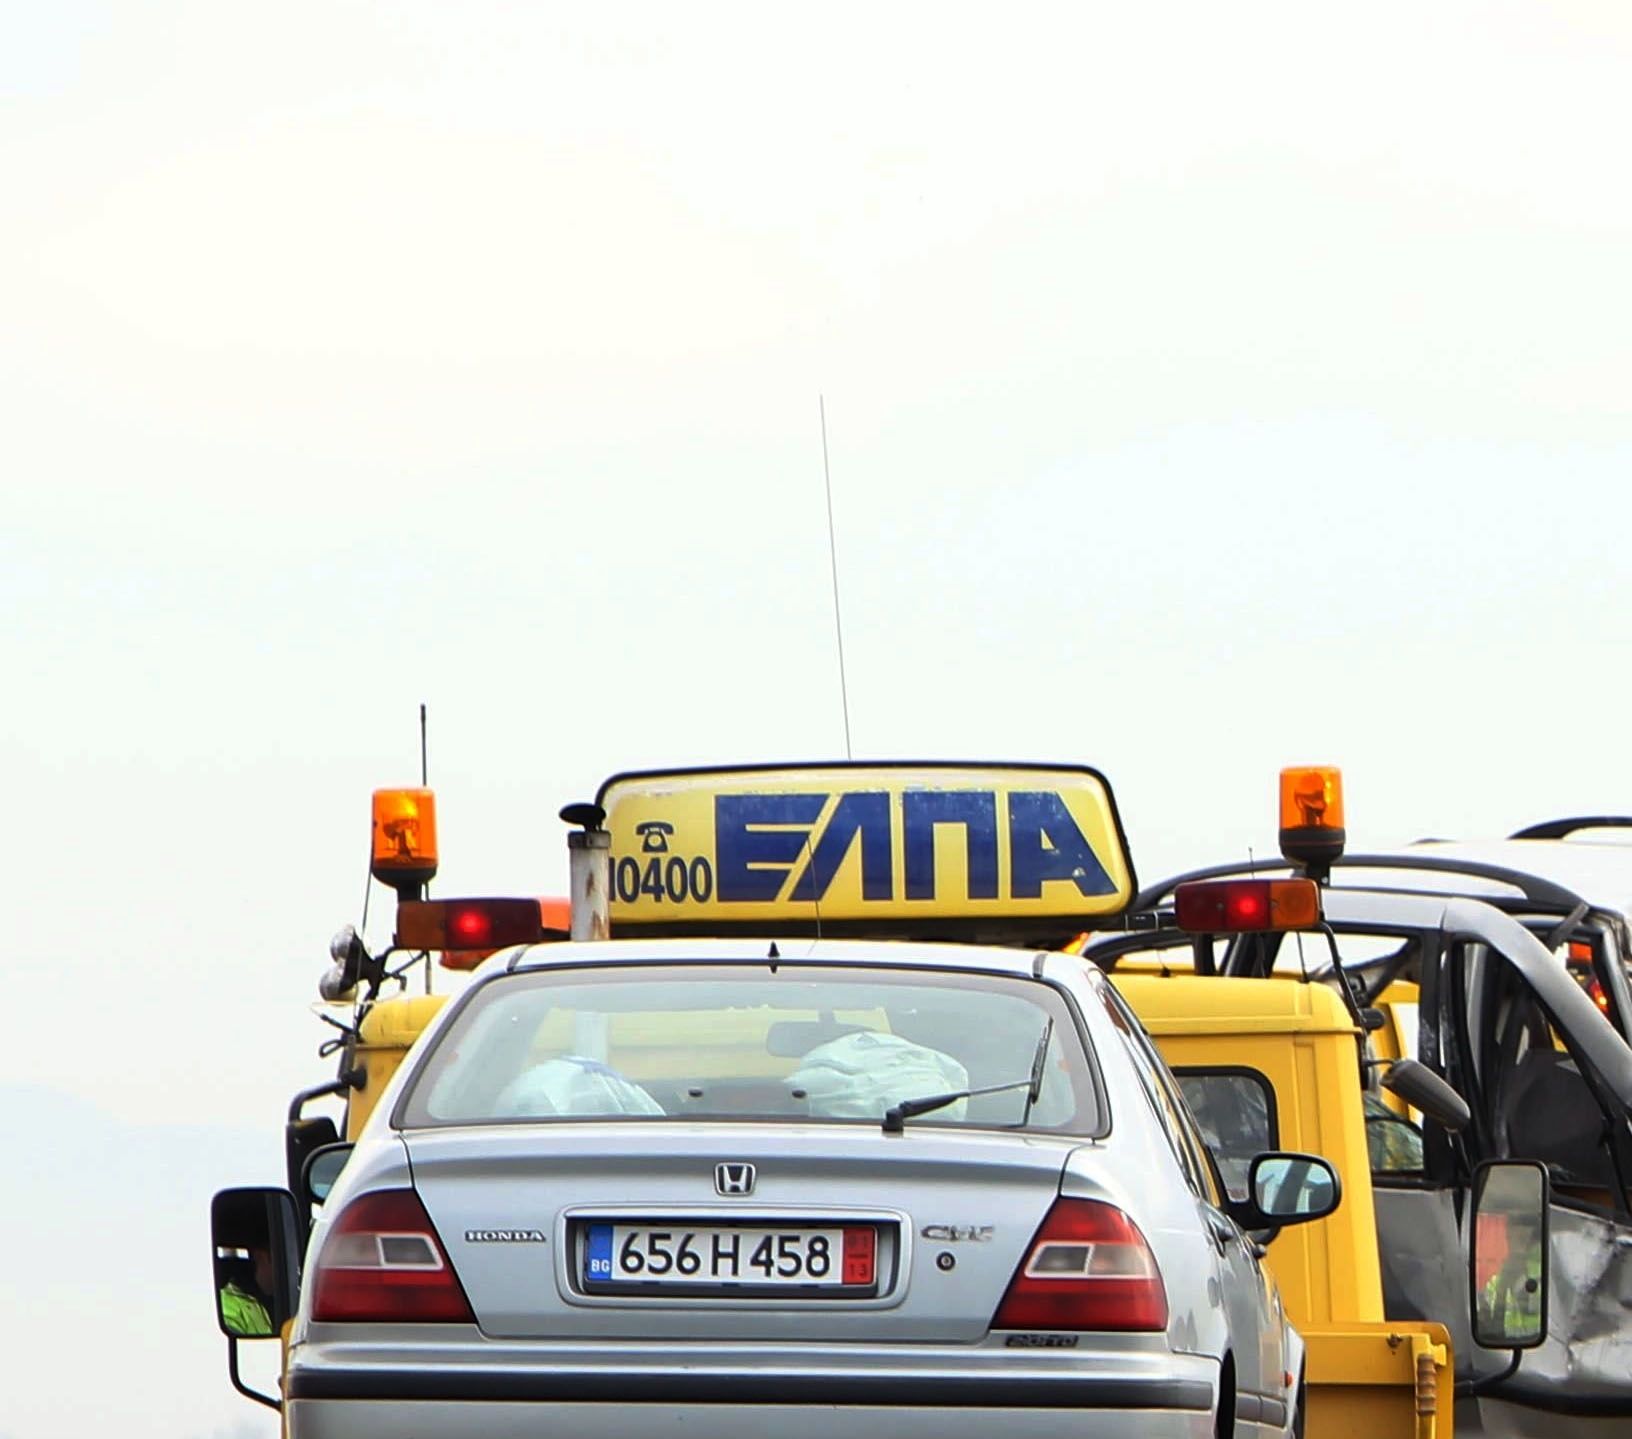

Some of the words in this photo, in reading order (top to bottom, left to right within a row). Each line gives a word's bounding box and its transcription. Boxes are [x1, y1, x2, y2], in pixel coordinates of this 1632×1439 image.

[608, 855, 713, 903] 10400
[466, 1230, 545, 1241] HONDA
[591, 1259, 610, 1272] BG
[619, 1232, 701, 1275] 656
[711, 1234, 740, 1277] H
[749, 1234, 830, 1278] 458
